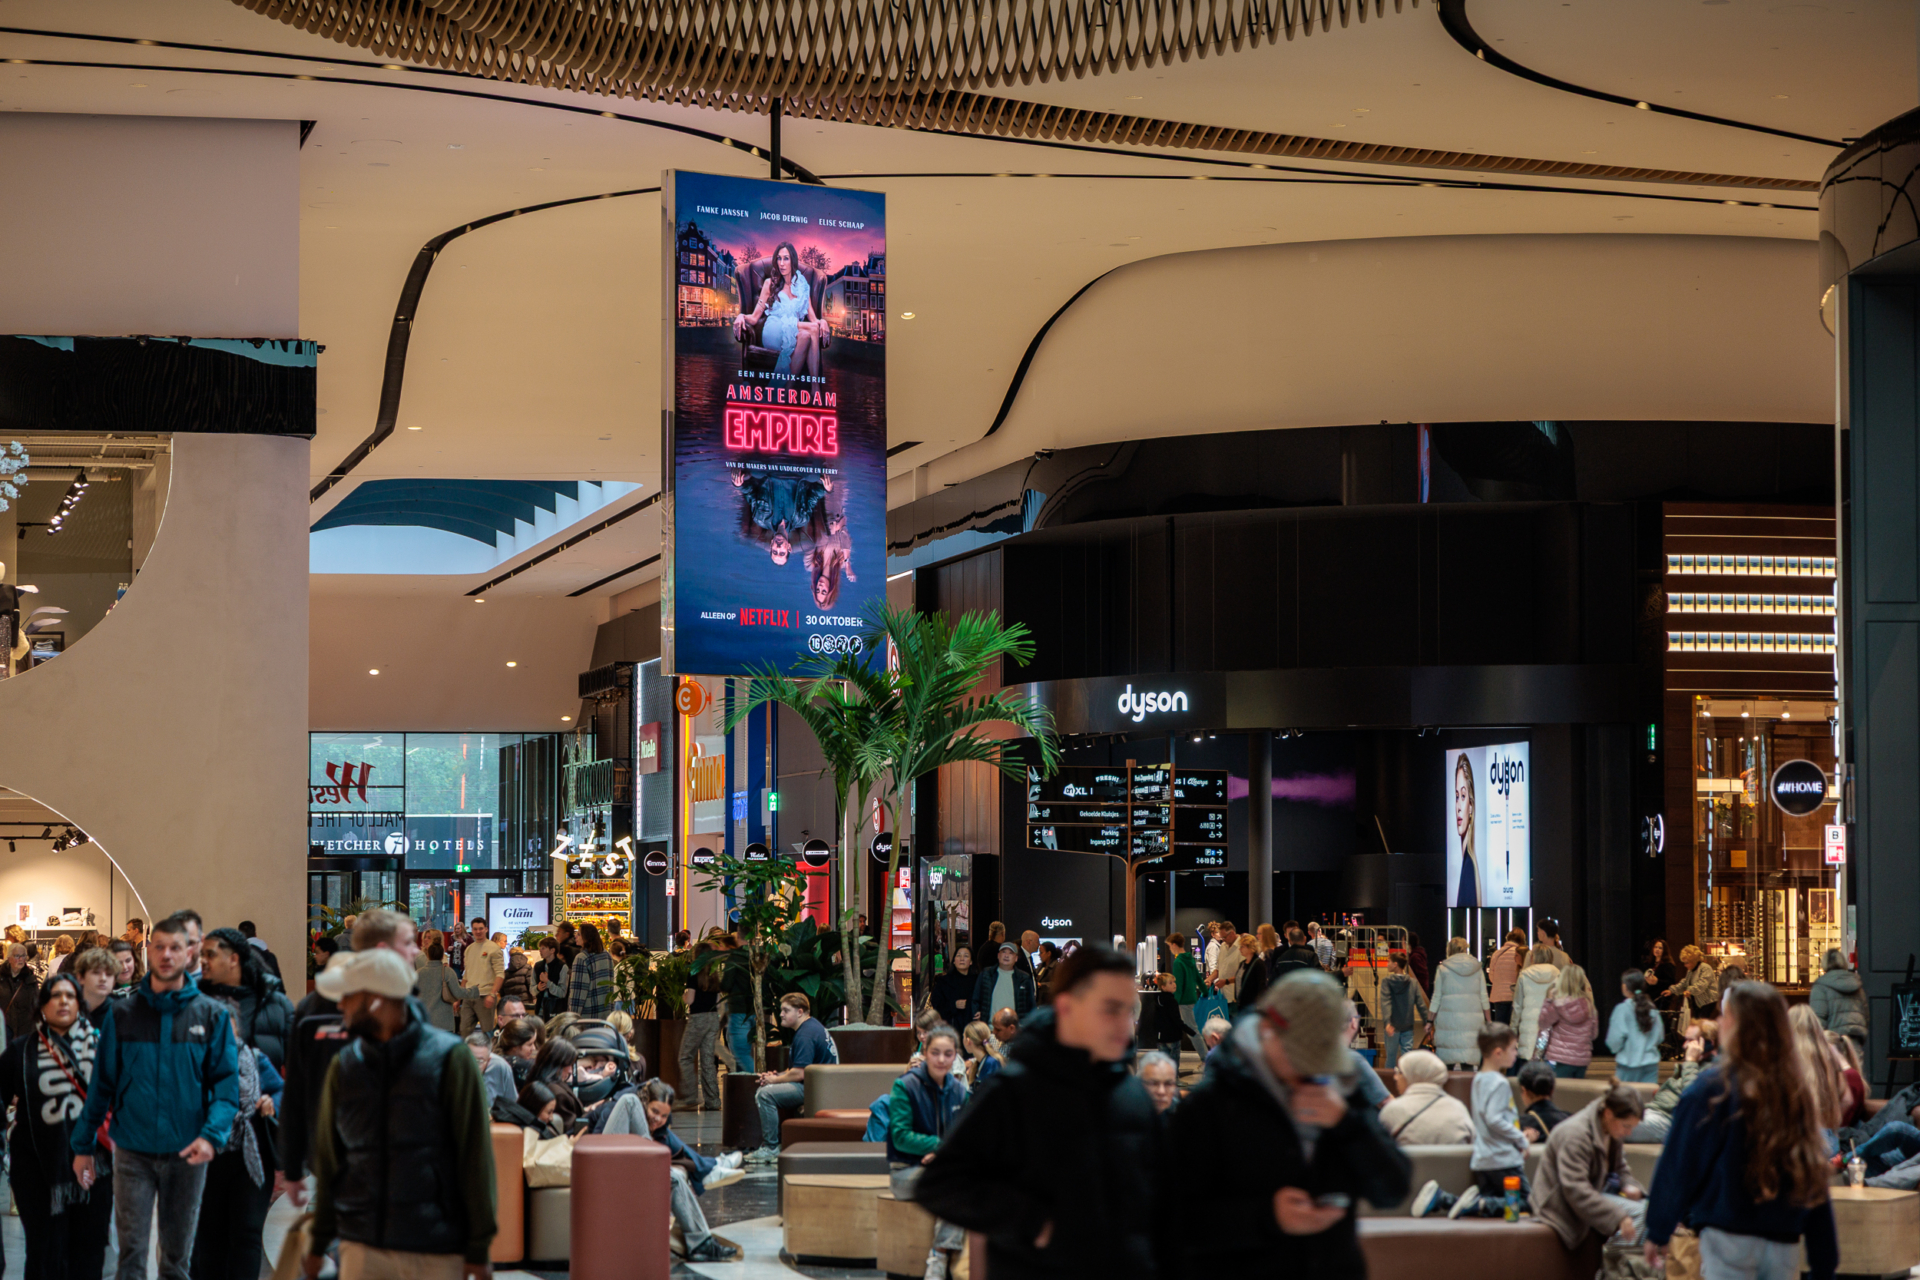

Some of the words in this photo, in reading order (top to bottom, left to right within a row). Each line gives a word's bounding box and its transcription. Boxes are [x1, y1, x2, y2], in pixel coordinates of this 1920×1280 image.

[696, 205, 719, 215] FAMKE
[720, 207, 749, 218] JANSSEN
[759, 211, 780, 221] JACOB
[782, 214, 808, 224] DERWIG
[818, 218, 837, 227] ELISE
[838, 220, 865, 230] SCHAAP
[737, 369, 755, 378] EEN
[758, 371, 826, 384] NETFLIX-SERIE
[726, 383, 837, 407] AMSTERDAM
[725, 409, 838, 455] EMPIRE
[745, 462, 767, 470] MAKERS
[779, 465, 814, 473] UNDERCOVER
[700, 611, 725, 620] ALLEEN
[726, 612, 737, 621] OP
[739, 607, 789, 629] NETFLIX
[805, 615, 818, 626] 30
[818, 615, 864, 628] OKTOBER
[811, 637, 821, 650] 16
[1117, 683, 1189, 723] dyson
[640, 738, 656, 760] Miele
[1101, 829, 1120, 838] Parking
[1832, 830, 1839, 840] B
[414, 840, 485, 851] HOTELS
[1090, 838, 1106, 847] Ingang
[549, 829, 636, 877] ZEST
[554, 883, 564, 923] ORDER
[503, 907, 534, 919] Glam
[1041, 916, 1073, 930] dyson
